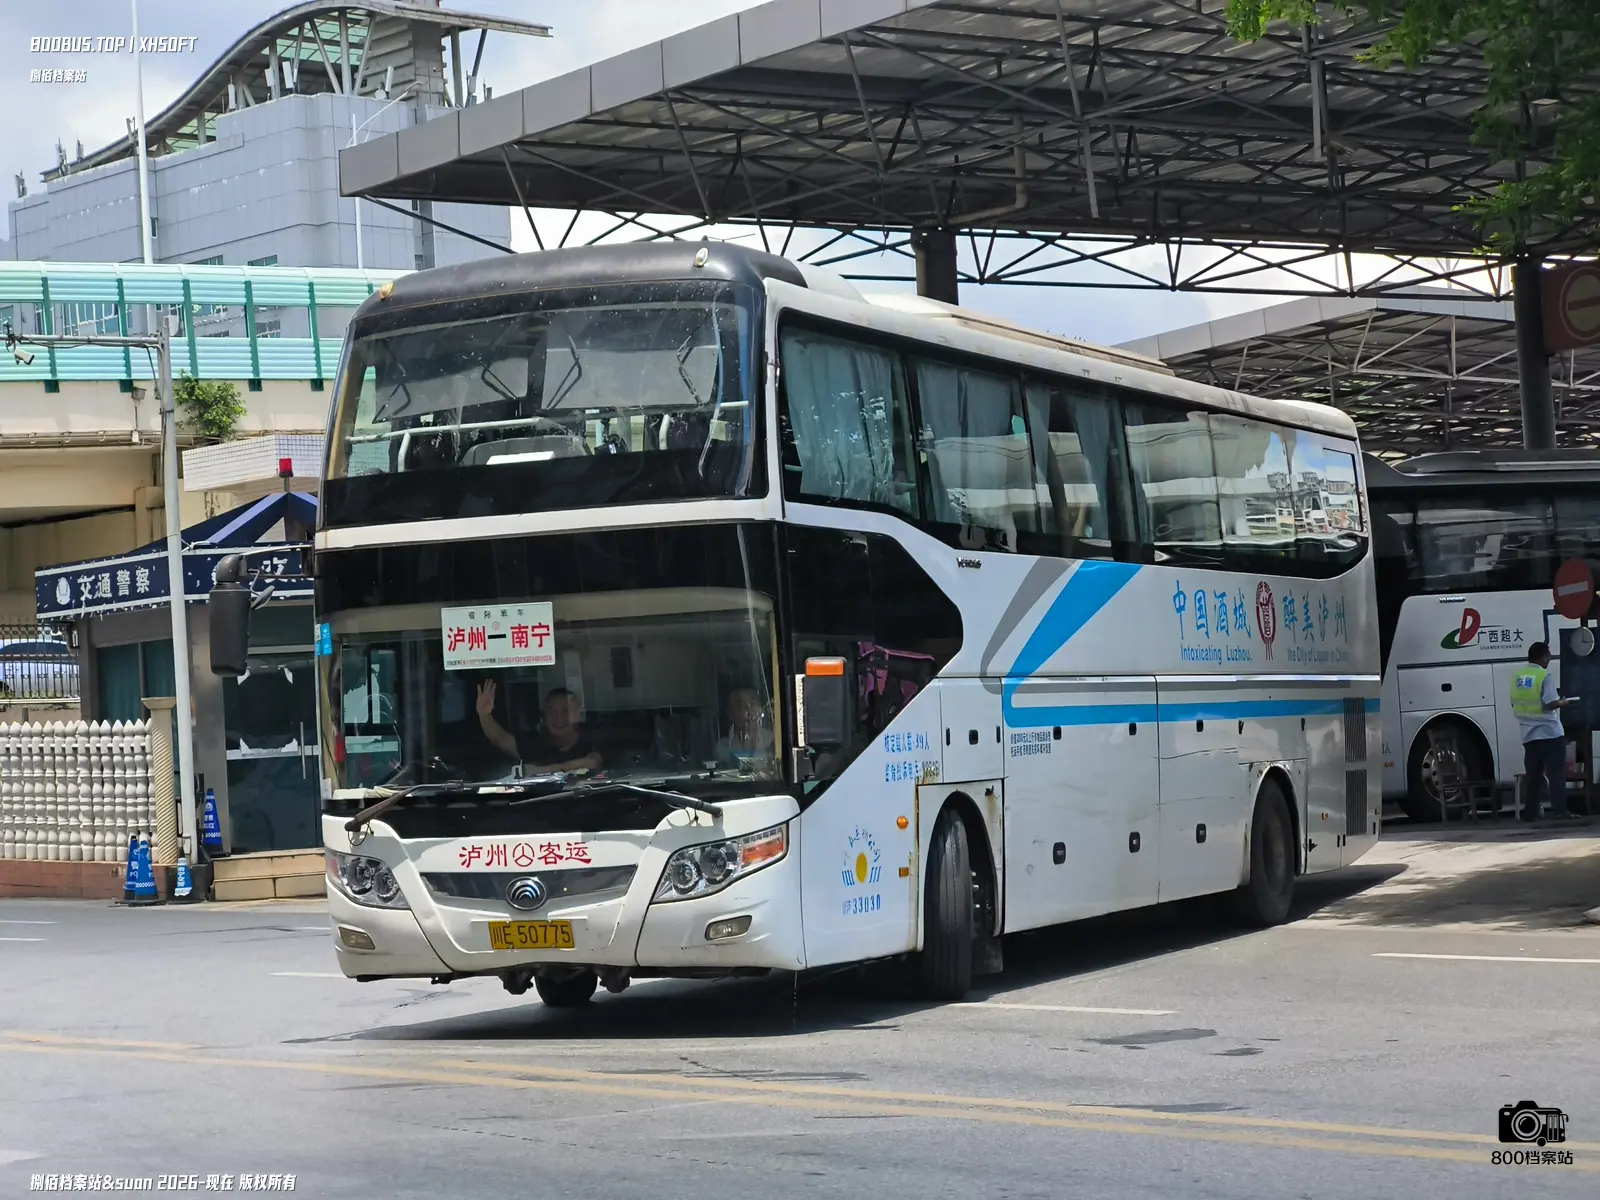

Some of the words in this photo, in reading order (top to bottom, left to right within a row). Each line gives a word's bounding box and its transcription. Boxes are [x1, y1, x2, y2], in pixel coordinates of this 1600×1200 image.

[77, 567, 150, 600] 交通警察
[1172, 580, 1252, 640] 中国酒城
[1282, 588, 1348, 643] 醉美泸州
[1477, 629, 1524, 643] 广西超大
[1181, 643, 1222, 665] Intoxicating
[459, 844, 507, 868] 泸州
[538, 841, 592, 865] 客运
